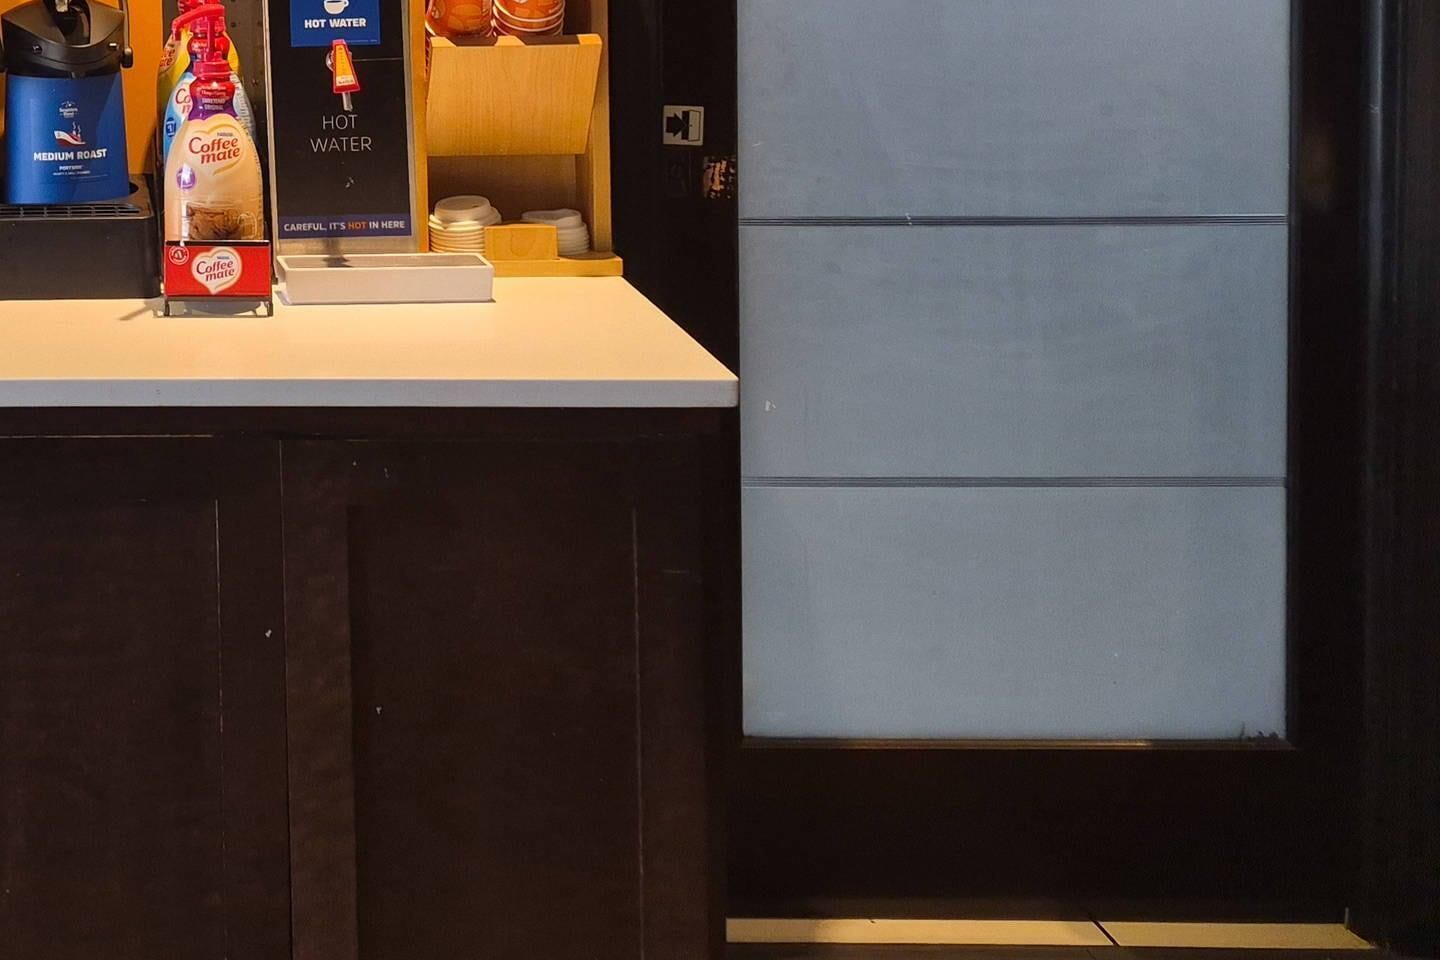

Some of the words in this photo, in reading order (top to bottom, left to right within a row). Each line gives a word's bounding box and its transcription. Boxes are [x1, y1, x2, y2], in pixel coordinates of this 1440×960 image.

[304, 19, 326, 28] HOT
[329, 18, 366, 28] WATER
[322, 114, 358, 130] HOT
[188, 136, 238, 154] Coffee
[310, 136, 372, 152] WATER
[33, 152, 74, 160] MEDIUM
[77, 148, 107, 159] ROAST
[201, 147, 240, 164] mate
[329, 222, 346, 230] IT'S
[348, 221, 367, 230] HOT
[369, 221, 379, 229] IN
[381, 220, 405, 229] HERE
[196, 260, 234, 275] Coffee
[206, 268, 235, 281] mate
